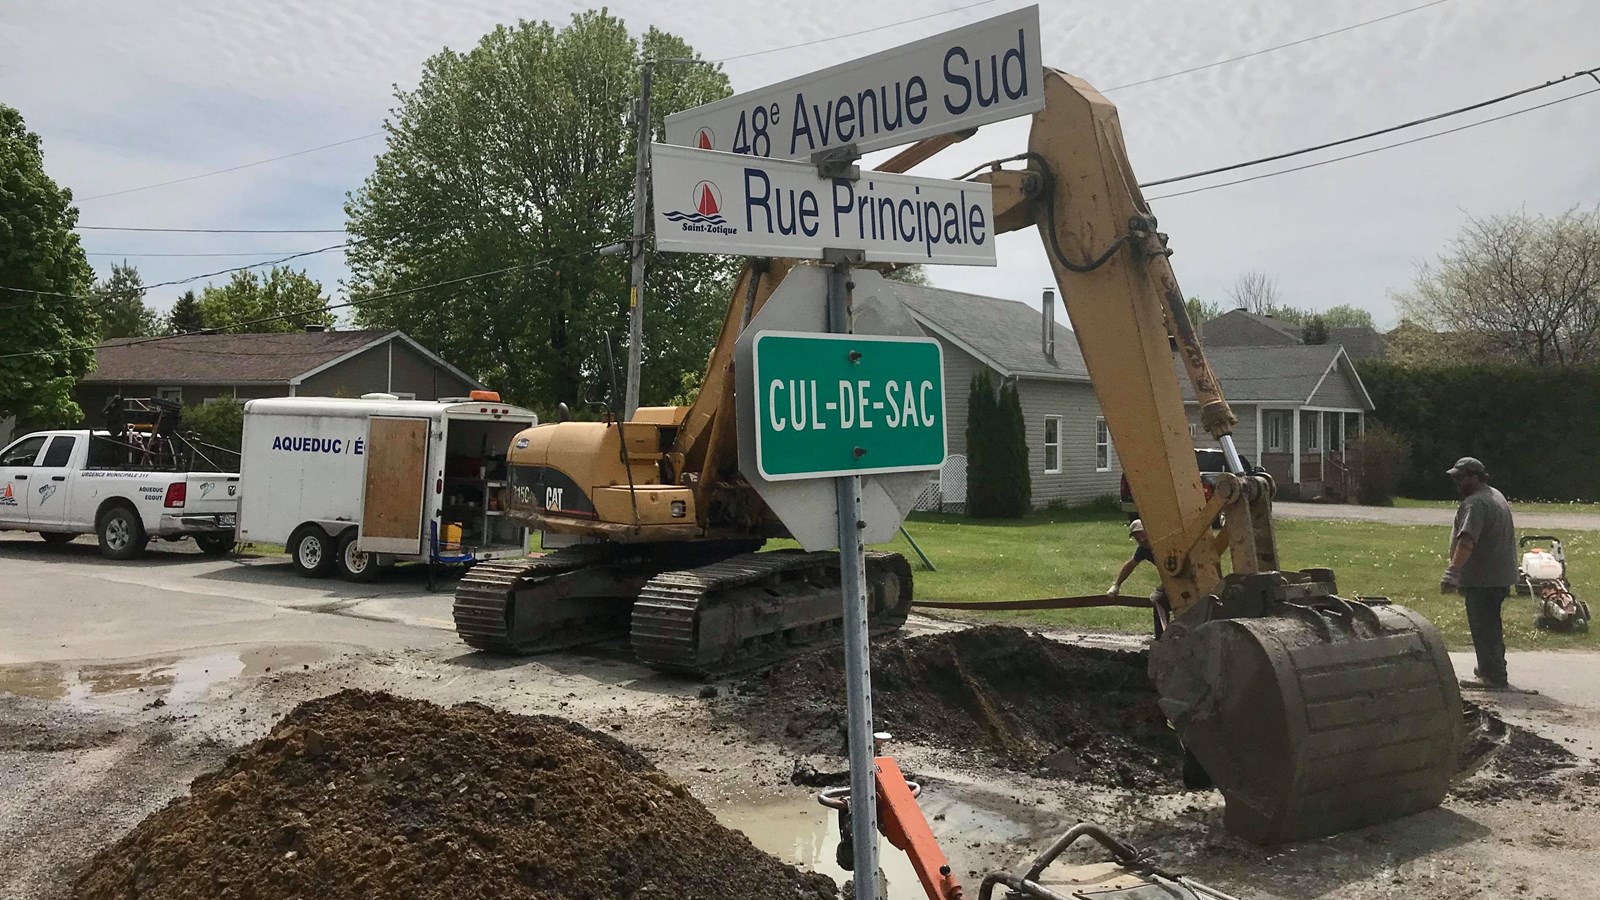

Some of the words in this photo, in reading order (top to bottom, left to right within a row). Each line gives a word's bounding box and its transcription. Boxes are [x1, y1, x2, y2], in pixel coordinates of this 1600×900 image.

[790, 75, 927, 155] Avenue
[943, 29, 1028, 115] Sud
[682, 222, 738, 236] Saint-Zotique
[744, 167, 819, 237] Rue
[832, 178, 986, 257] Principale
[769, 378, 935, 432] CUL-DE-SAC
[272, 436, 342, 454] AQUEDUC
[345, 440, 350, 454] /
[354, 437, 365, 454] É
[546, 487, 563, 511] CAT
